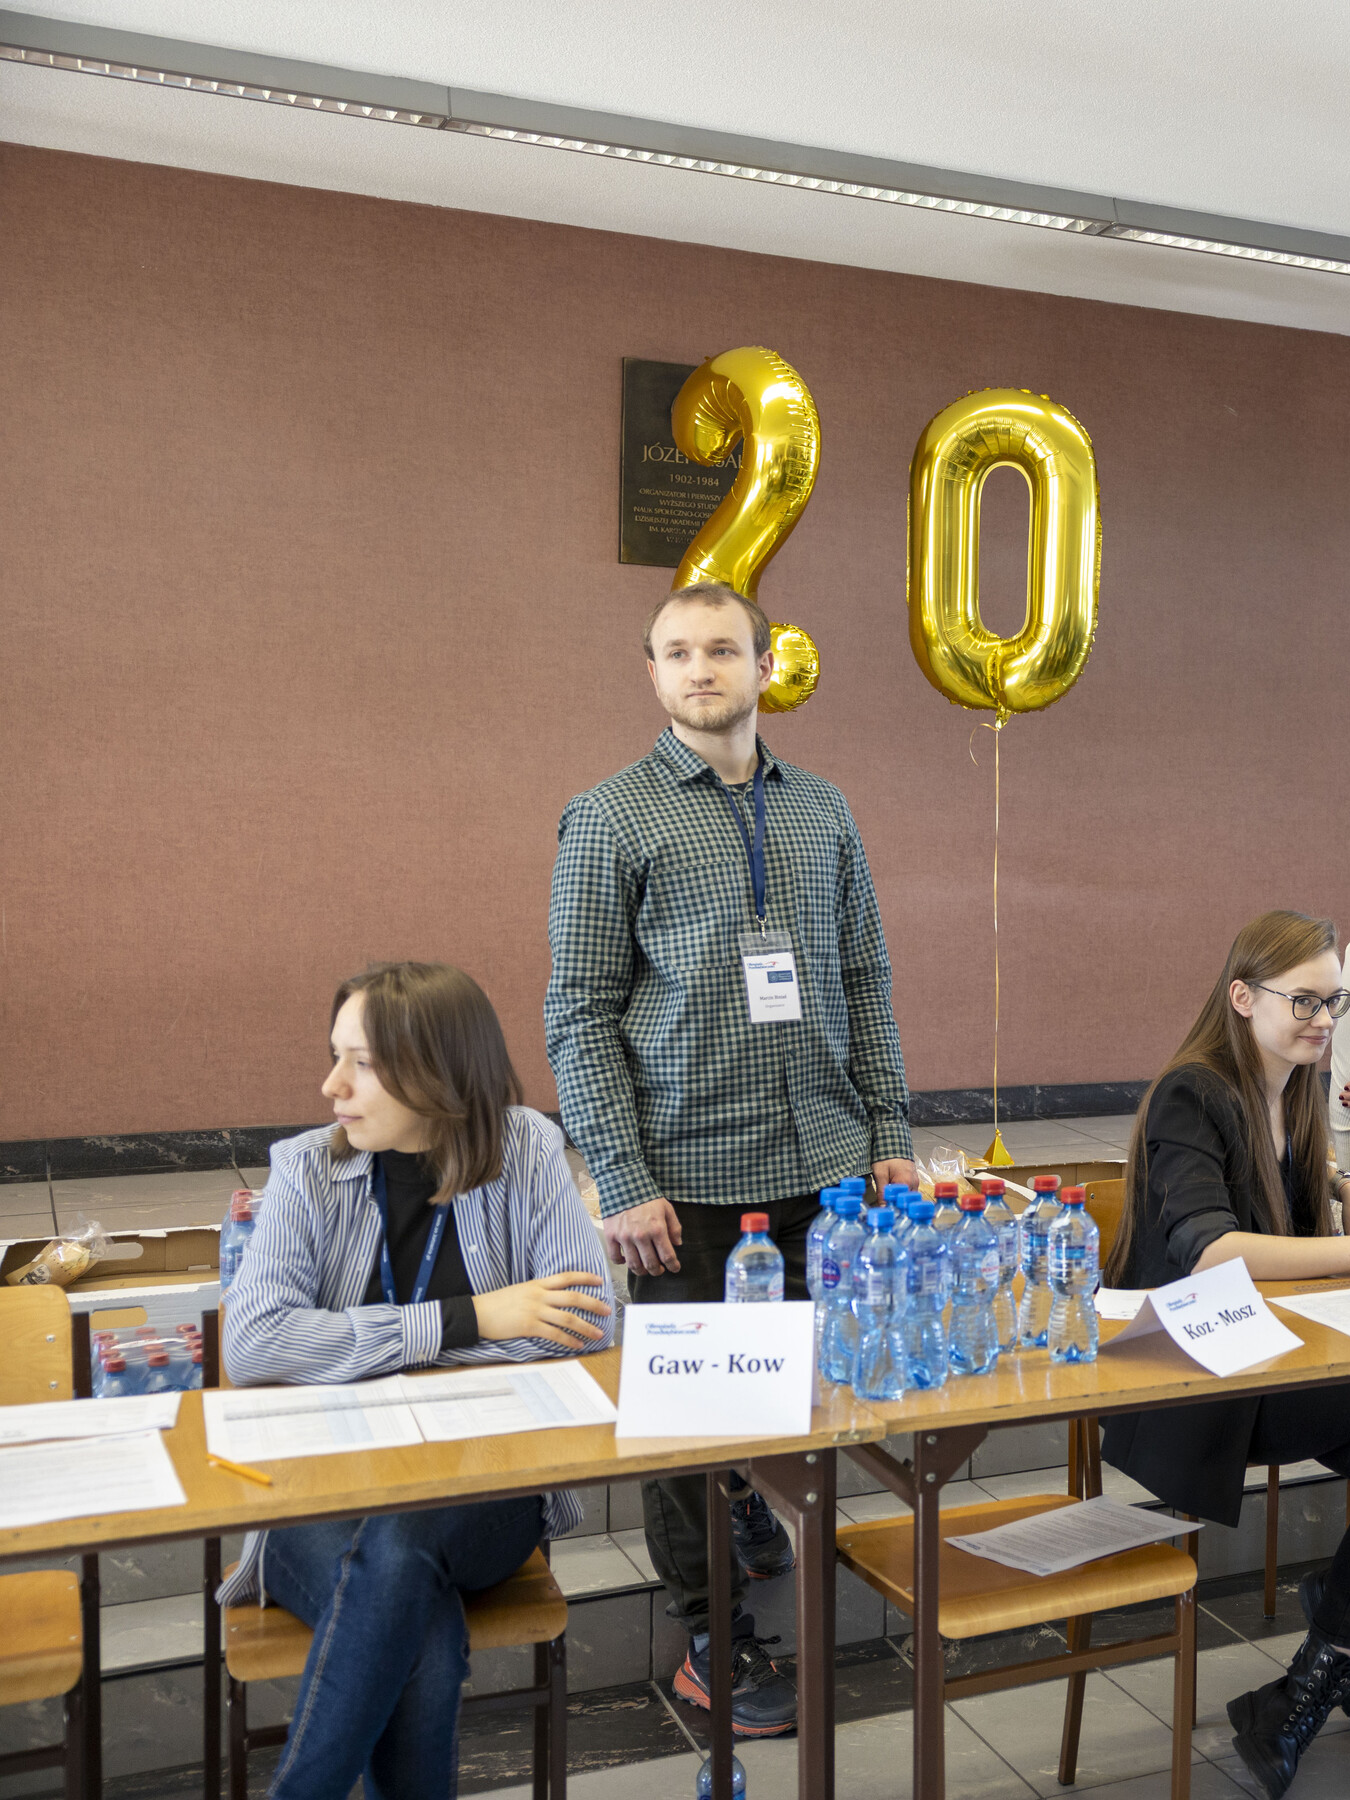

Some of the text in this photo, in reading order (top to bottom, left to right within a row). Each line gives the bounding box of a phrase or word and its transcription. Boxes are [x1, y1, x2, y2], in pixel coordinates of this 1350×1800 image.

[669, 473, 720, 487] 1902-1984
[639, 488, 686, 498] ORGANIZATOR
[691, 493, 722, 502] PIERWSZY
[659, 498, 696, 508] WYŻSZEGO
[1182, 1321, 1215, 1340] Koz
[1217, 1304, 1257, 1327] Mosz
[648, 1354, 705, 1376] Gaw
[727, 1353, 785, 1374] Kow
